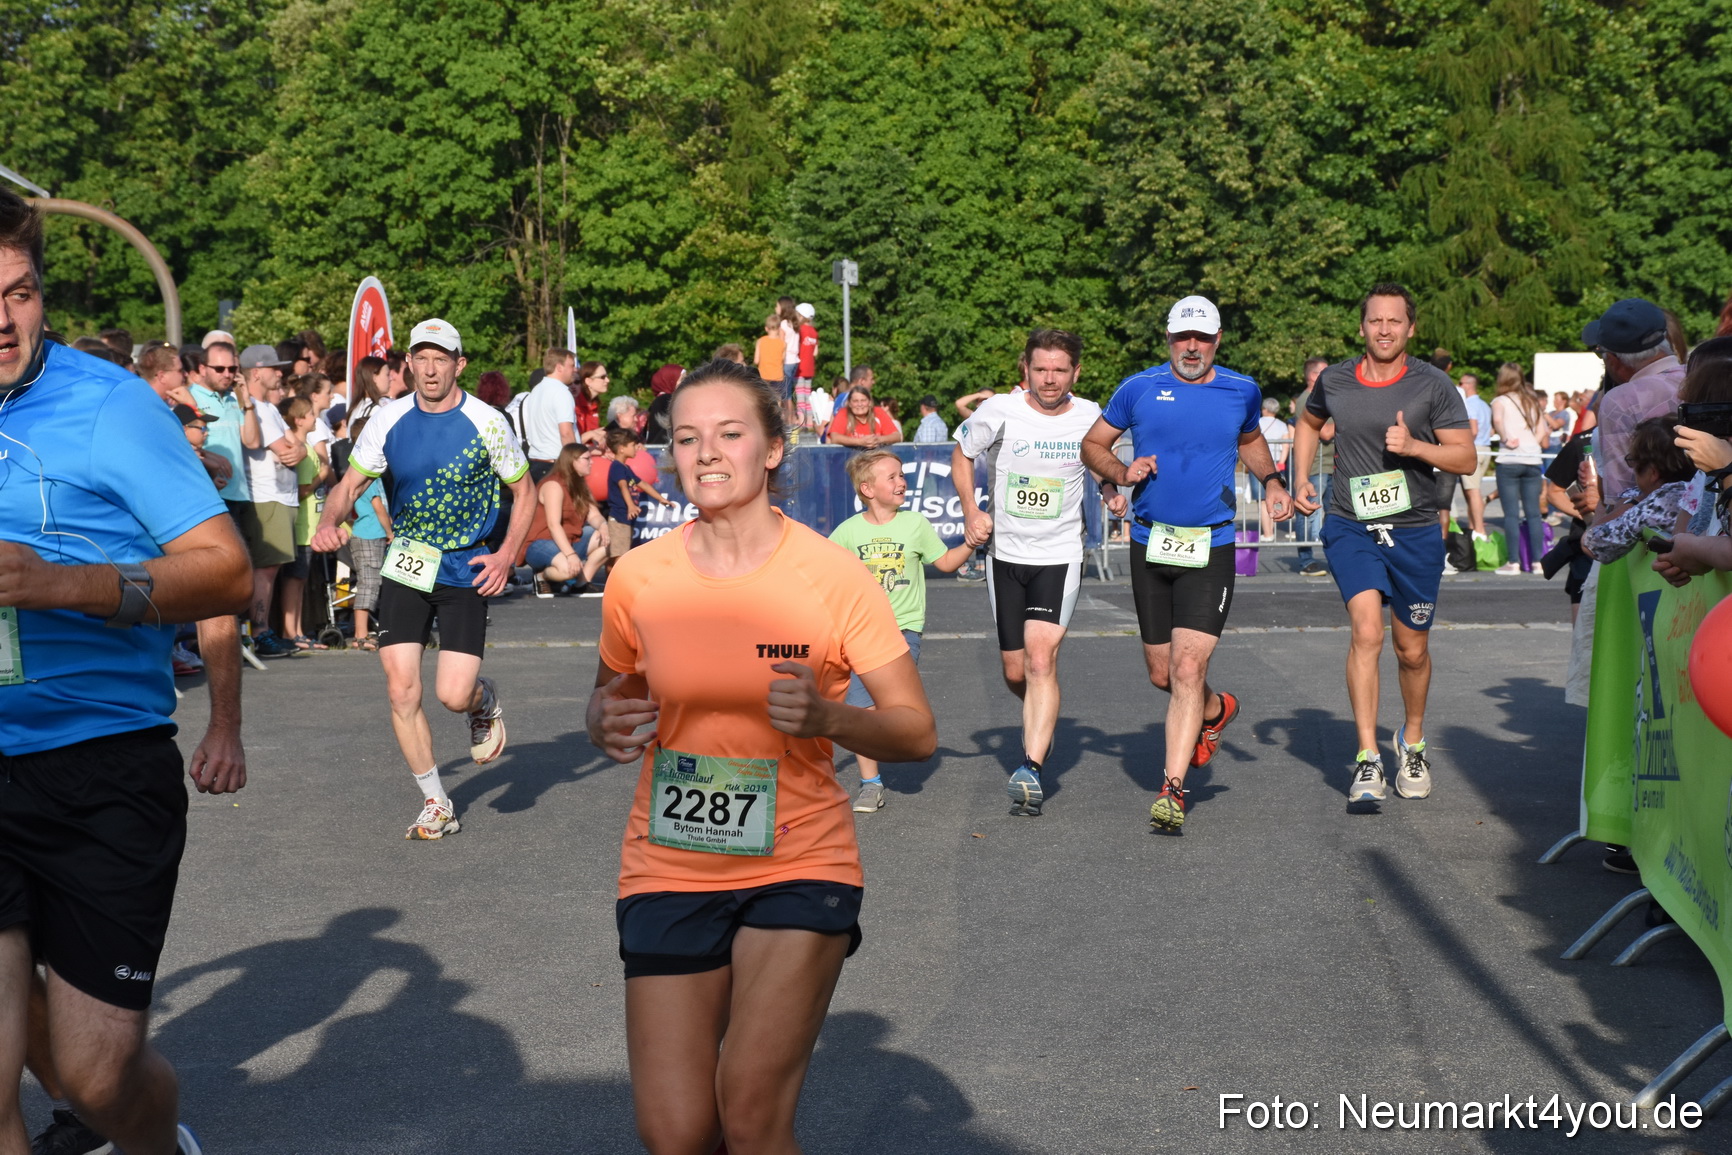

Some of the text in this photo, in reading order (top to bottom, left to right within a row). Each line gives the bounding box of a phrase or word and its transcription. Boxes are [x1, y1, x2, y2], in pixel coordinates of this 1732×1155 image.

[1040, 451, 1077, 459] TREPPEN
[1017, 490, 1050, 507] 999
[1359, 485, 1400, 507] 1487
[1161, 537, 1196, 553] 574
[395, 552, 424, 576] 232
[756, 644, 810, 659] THULE
[669, 768, 715, 784] firmenlauf
[743, 784, 768, 793] 2019
[662, 785, 757, 827] 2287
[673, 822, 743, 838] Bytom Hannah
[687, 833, 727, 844] Thule GmbH
